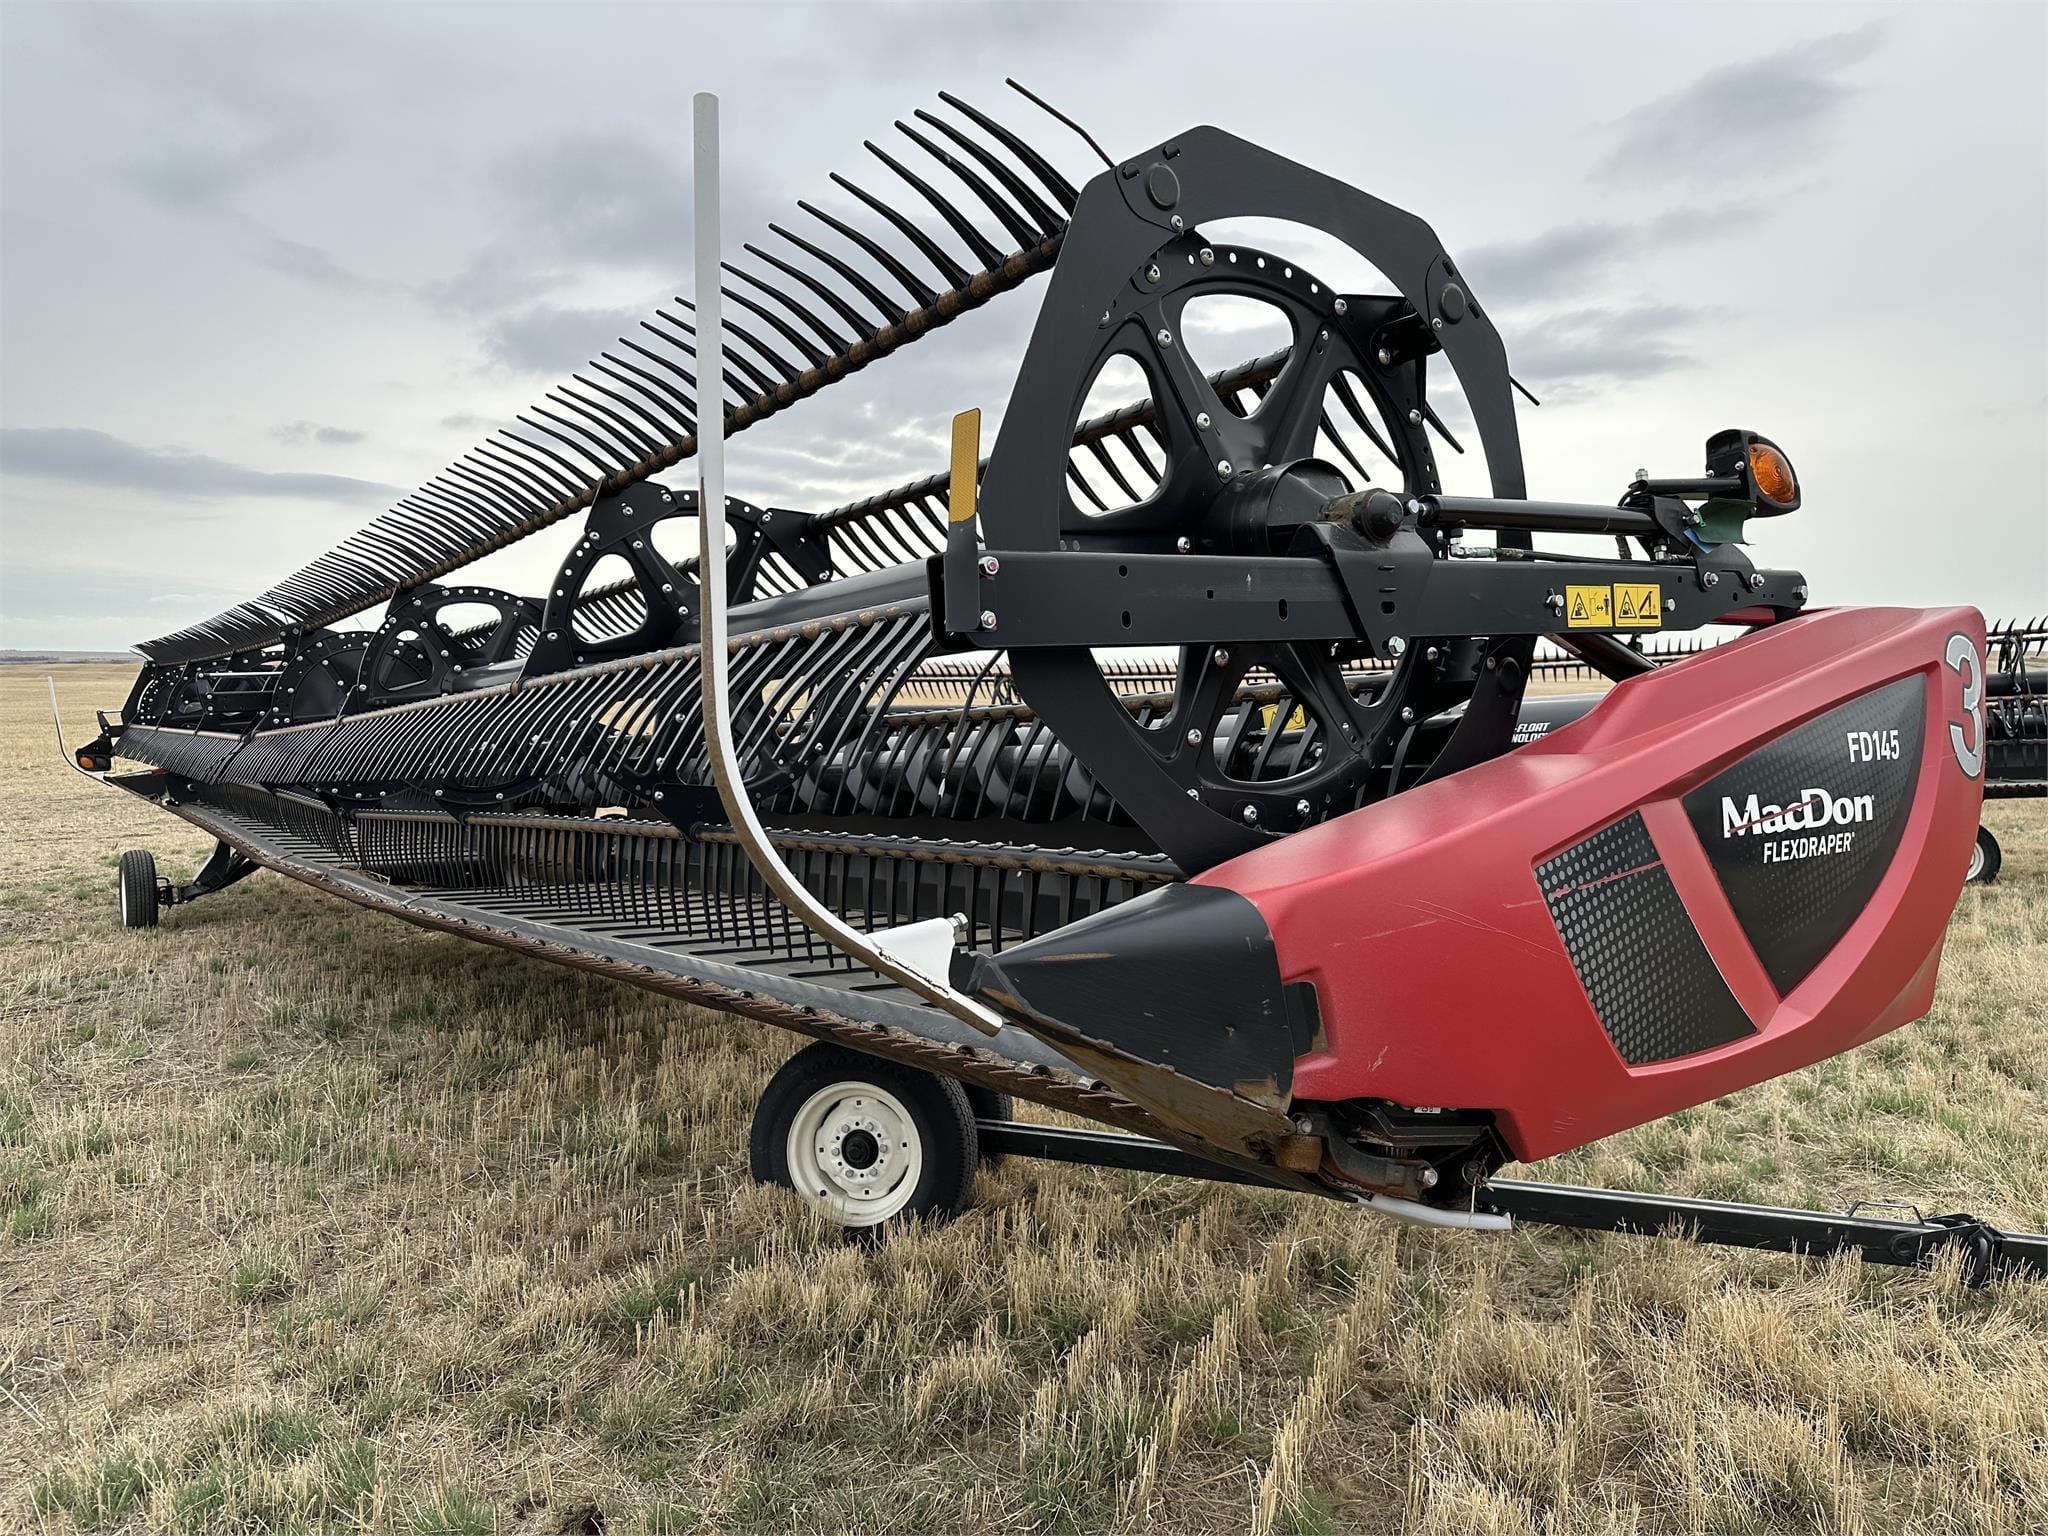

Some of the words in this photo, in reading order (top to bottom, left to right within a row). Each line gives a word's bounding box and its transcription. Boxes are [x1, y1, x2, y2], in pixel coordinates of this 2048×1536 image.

[1946, 633, 1984, 778] 3
[1847, 729, 1900, 763] FD145
[1721, 787, 1874, 839] MacDon
[1763, 831, 1852, 864] FLEXDRAPER
